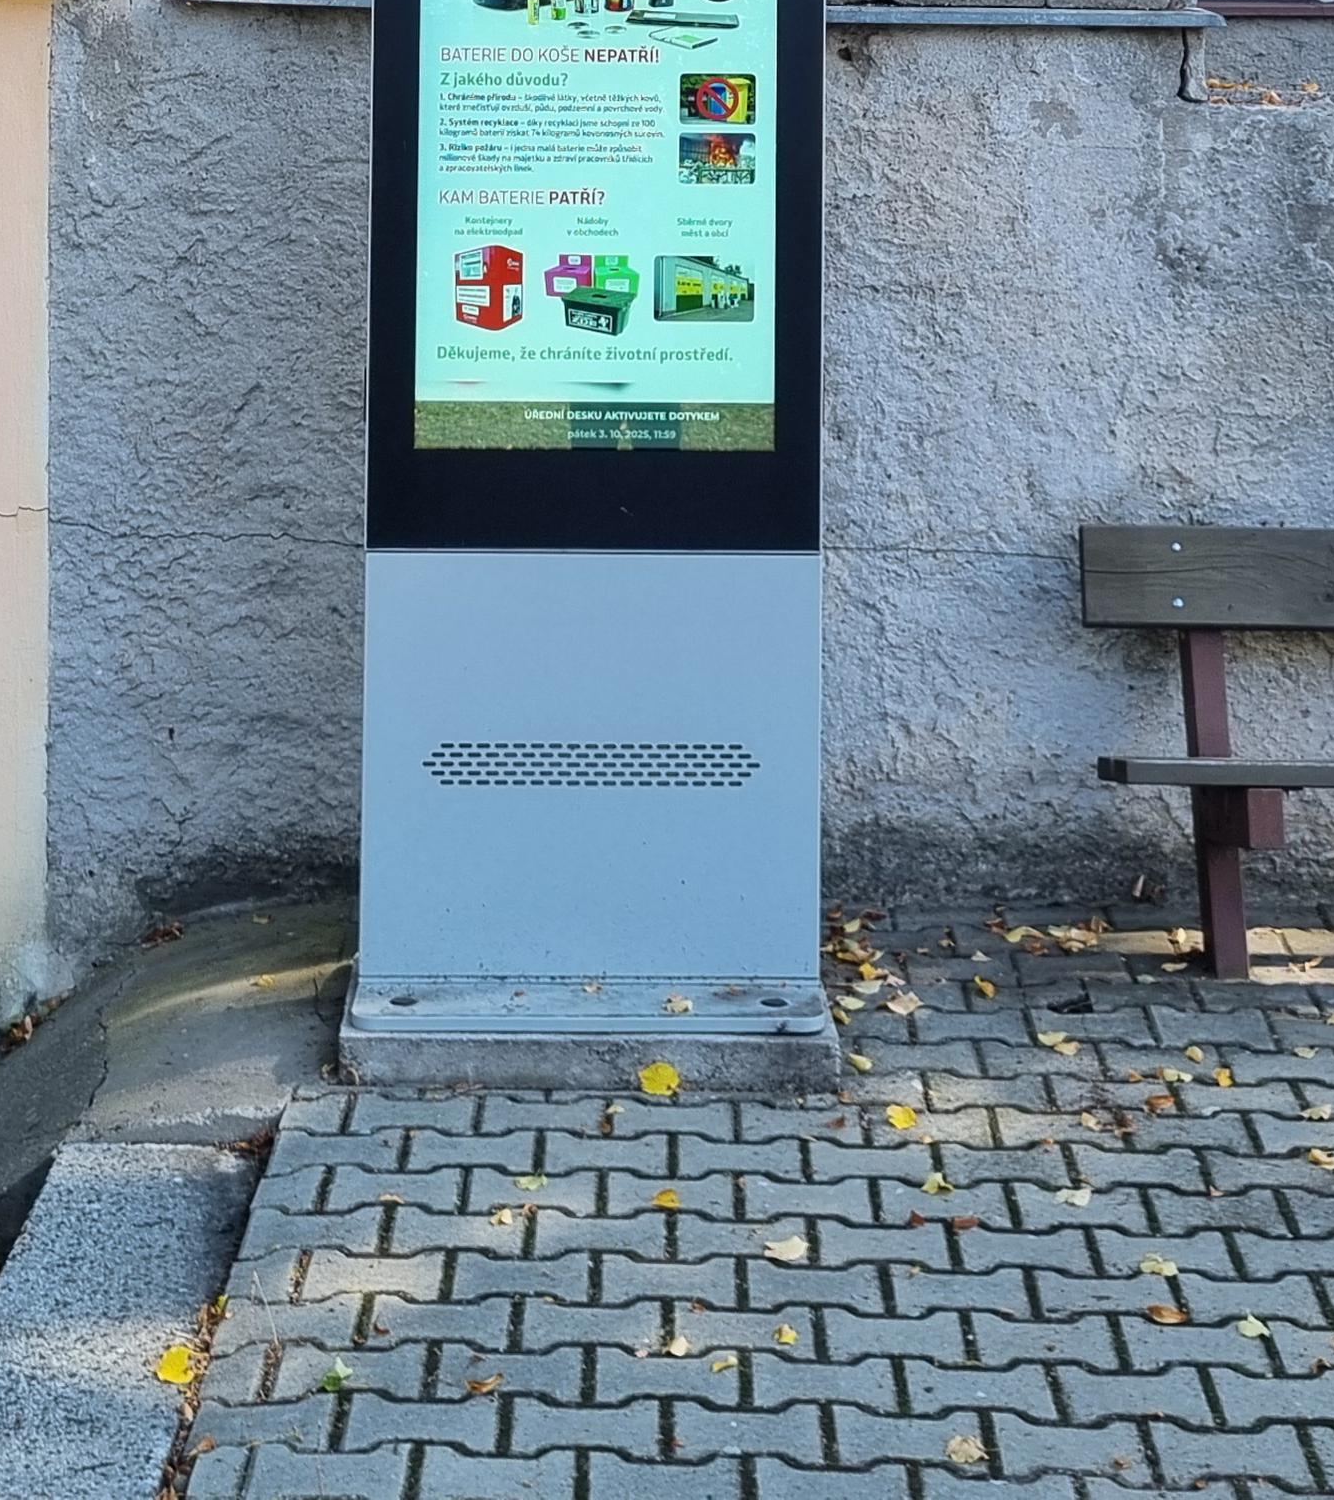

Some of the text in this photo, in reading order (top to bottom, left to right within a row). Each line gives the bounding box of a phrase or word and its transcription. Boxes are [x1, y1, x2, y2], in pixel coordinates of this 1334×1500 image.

[440, 44, 659, 63] BATERIE DO KOŠE NEPATŘÍ!
[439, 71, 568, 88] Z jakého důvodu?
[439, 187, 605, 205] KAM BATERIE PATŘÍ?
[437, 345, 733, 364] Děkujeme, že chráníte životní prostředí.
[524, 407, 720, 422] ÚŘEDNÍ DESKU AKTIVUJETE DOTYKEM
[567, 429, 596, 440] pátek
[598, 430, 607, 439] 3.
